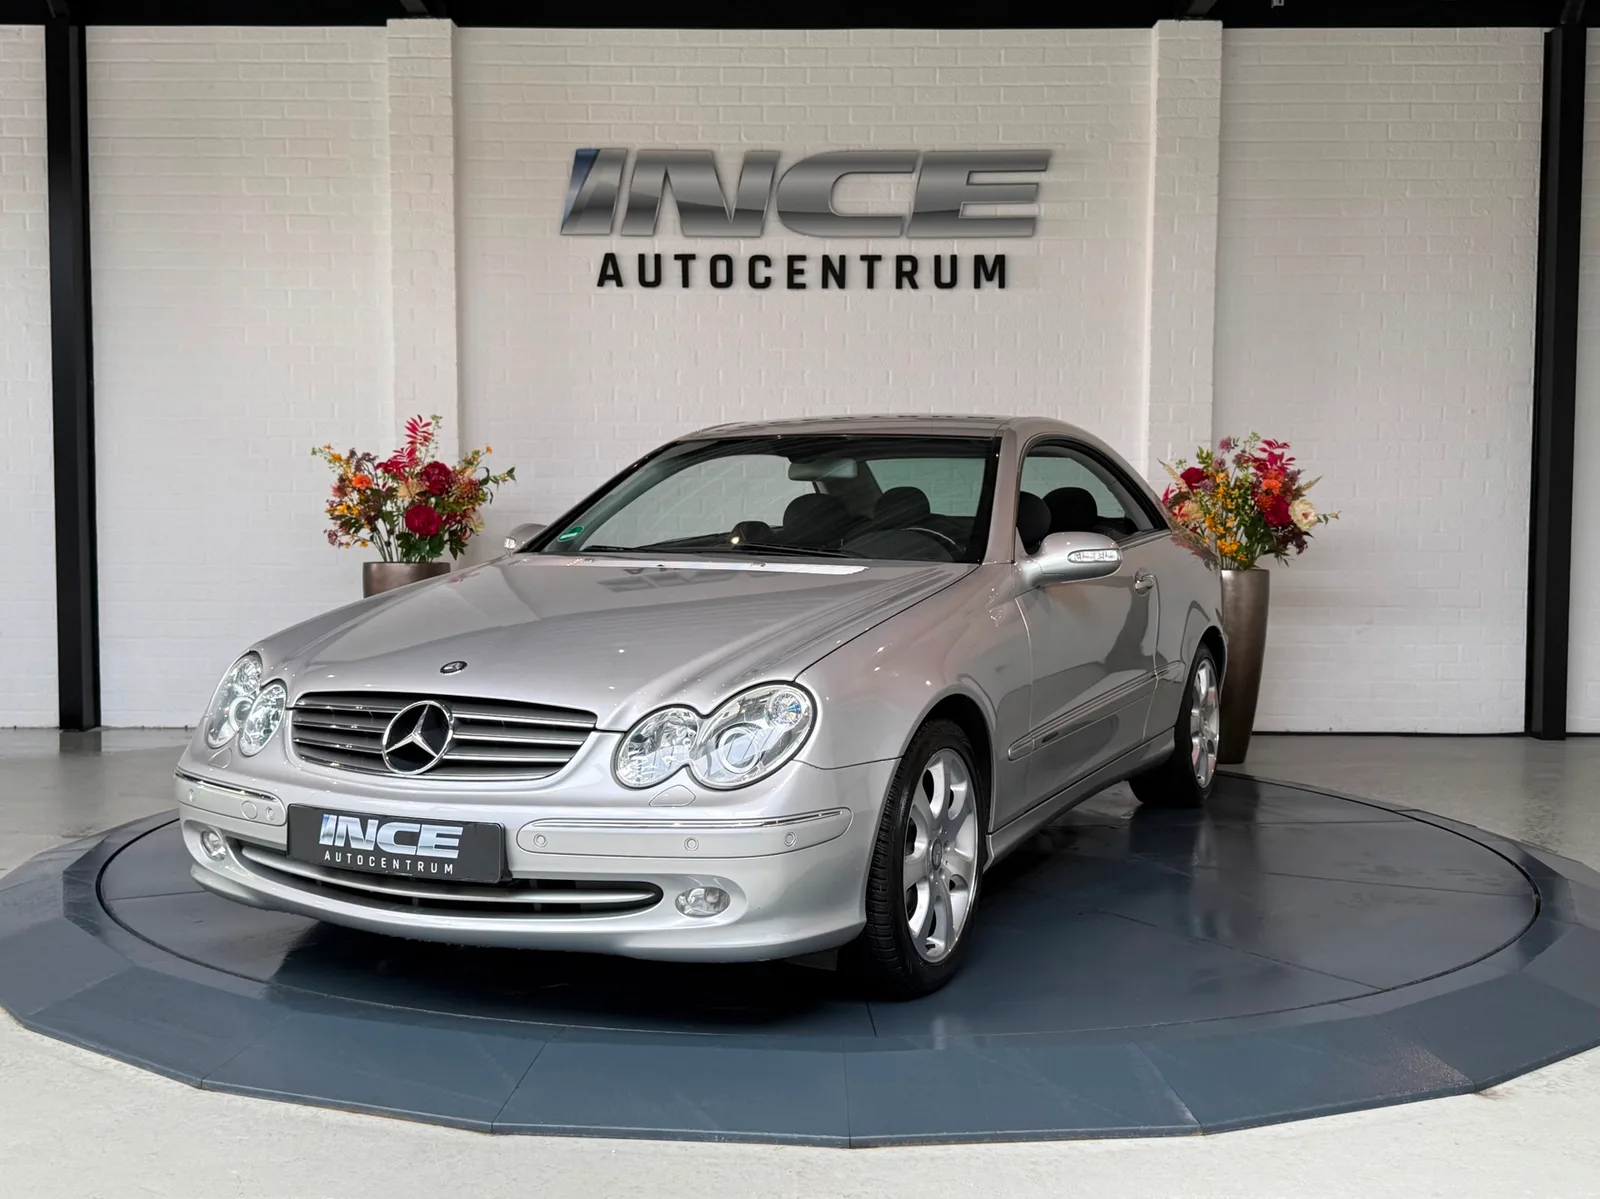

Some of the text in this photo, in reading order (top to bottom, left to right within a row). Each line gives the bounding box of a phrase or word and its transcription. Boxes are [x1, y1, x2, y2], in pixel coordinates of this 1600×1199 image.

[561, 148, 1051, 237] INCE
[597, 253, 1007, 289] AUTOCENTRUM
[319, 814, 463, 858] INCE
[324, 851, 453, 874] AUTOCENTRUM
